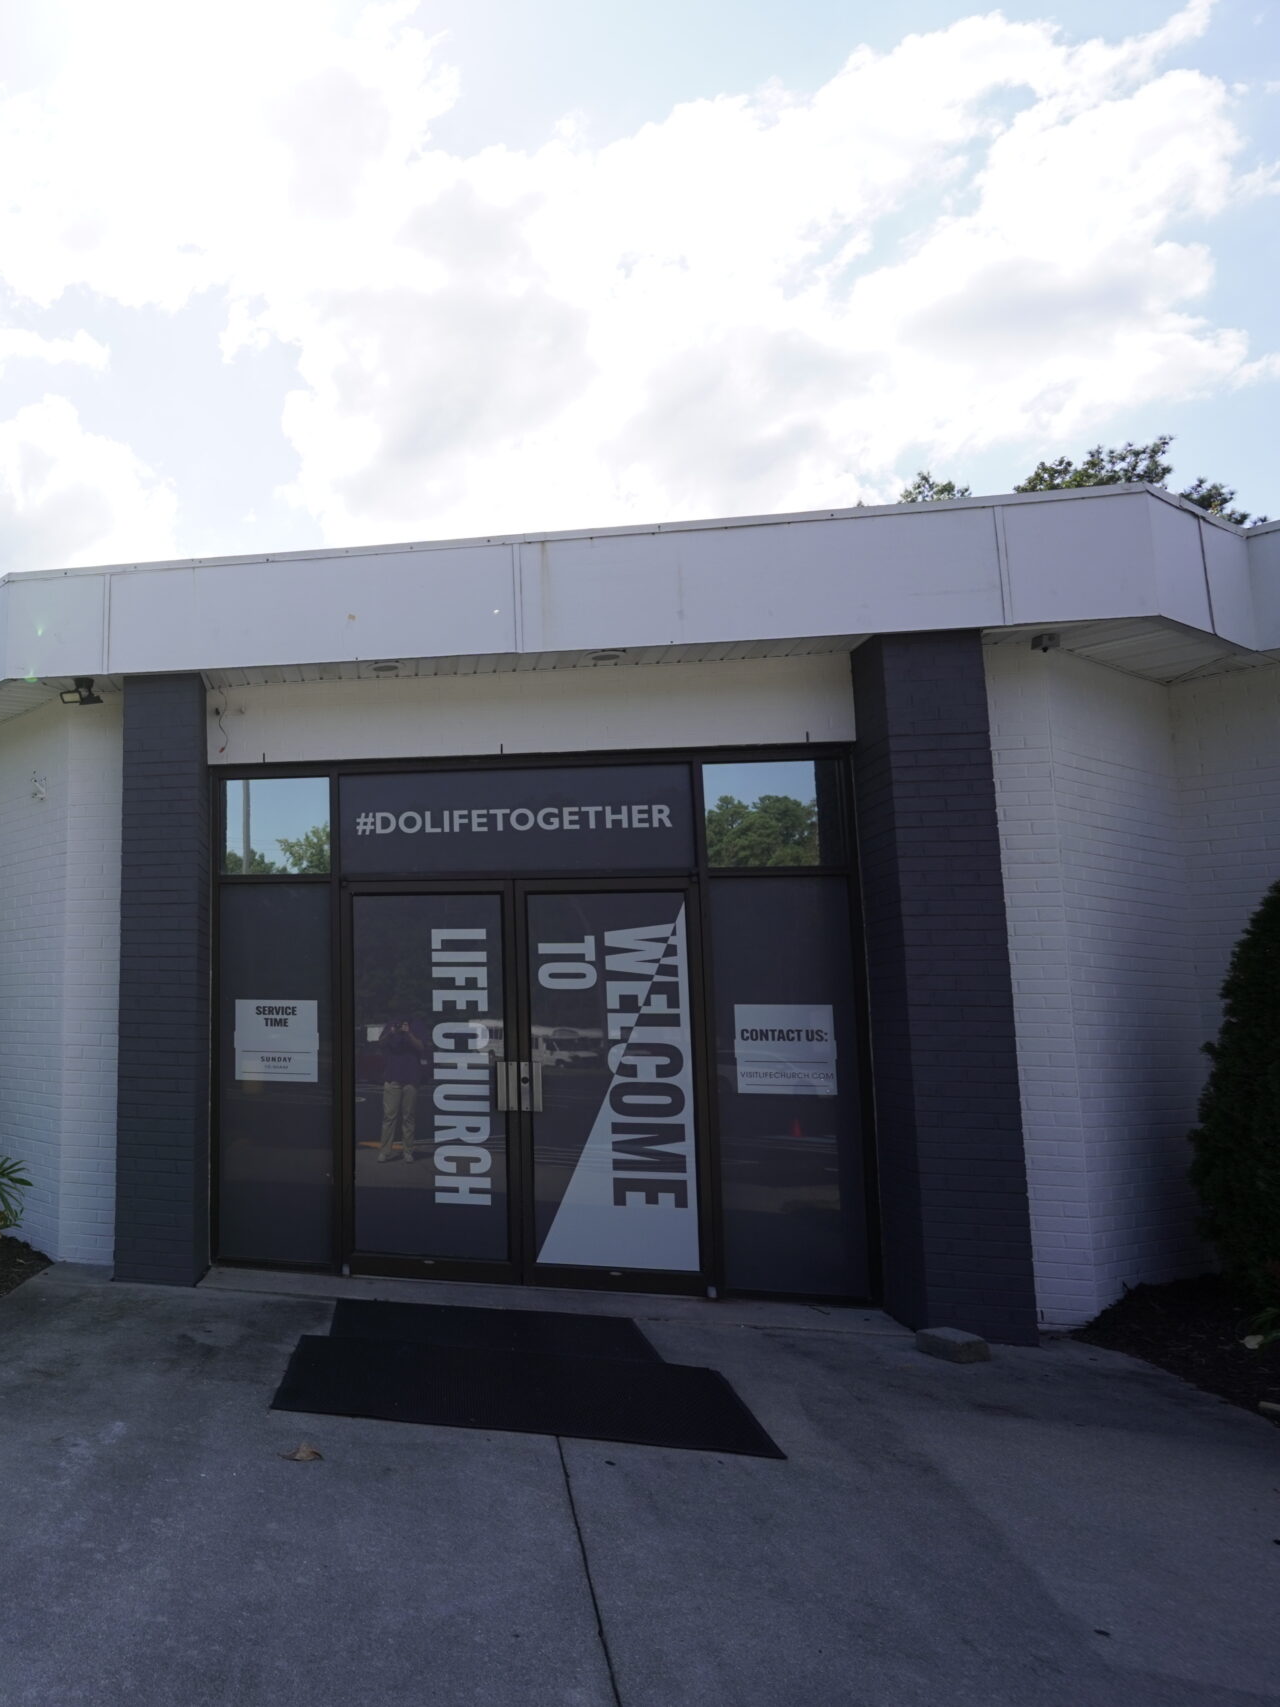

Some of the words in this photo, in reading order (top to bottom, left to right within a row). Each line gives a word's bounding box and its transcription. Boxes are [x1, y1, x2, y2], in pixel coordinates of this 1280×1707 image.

[356, 804, 673, 835] #DOLIFETOGETHER
[537, 935, 598, 990] TO
[255, 1005, 297, 1016] SERVICE
[264, 1017, 289, 1028] TIME
[740, 1028, 803, 1042] CONTACT
[805, 1028, 829, 1042] US:
[604, 922, 689, 1209] WELCOME
[740, 1071, 834, 1080] VISITLIFECHURCHCOM
